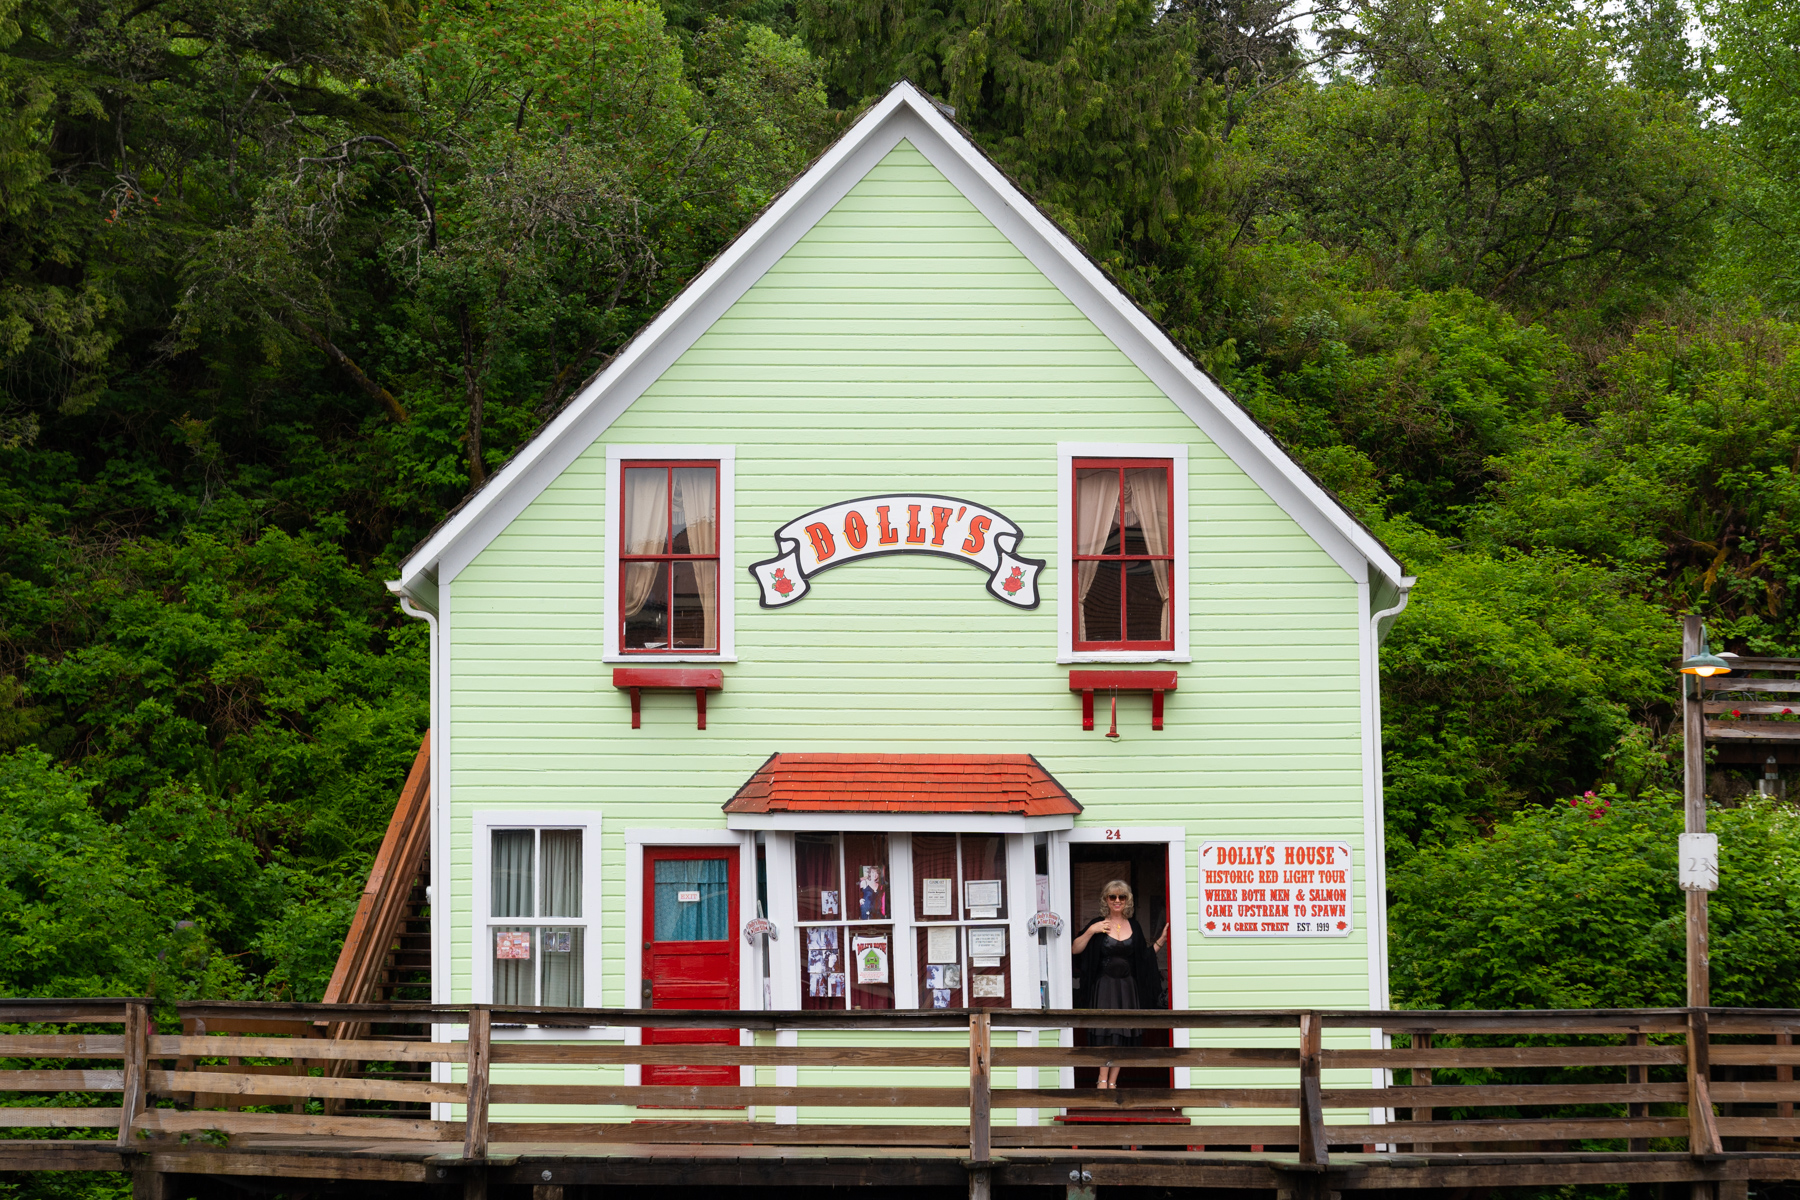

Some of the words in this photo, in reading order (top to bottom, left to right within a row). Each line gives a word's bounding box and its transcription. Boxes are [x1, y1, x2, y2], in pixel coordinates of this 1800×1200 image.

[803, 504, 992, 564] DOLLY'S
[1105, 829, 1121, 840] 24
[1216, 845, 1275, 865] DOLLY'S
[1284, 846, 1335, 865] HOUSE
[1687, 857, 1709, 872] 23
[1258, 870, 1279, 884] RED
[1283, 870, 1315, 884] LIGHT
[1204, 888, 1237, 902] WHERE
[1241, 888, 1266, 902] BOTH
[1270, 888, 1290, 902] MEN
[1295, 888, 1306, 902] &
[1309, 888, 1347, 902] SALMON
[1205, 904, 1233, 918] CAME
[1237, 904, 1289, 918] UPSTREAM
[1294, 904, 1307, 918] TO
[1311, 904, 1346, 918] SPAWN
[1222, 922, 1231, 932] 24
[1234, 922, 1258, 932] CREEK
[1261, 922, 1290, 932] STREET
[1296, 922, 1313, 932] EST.
[1316, 922, 1330, 932] 1919
